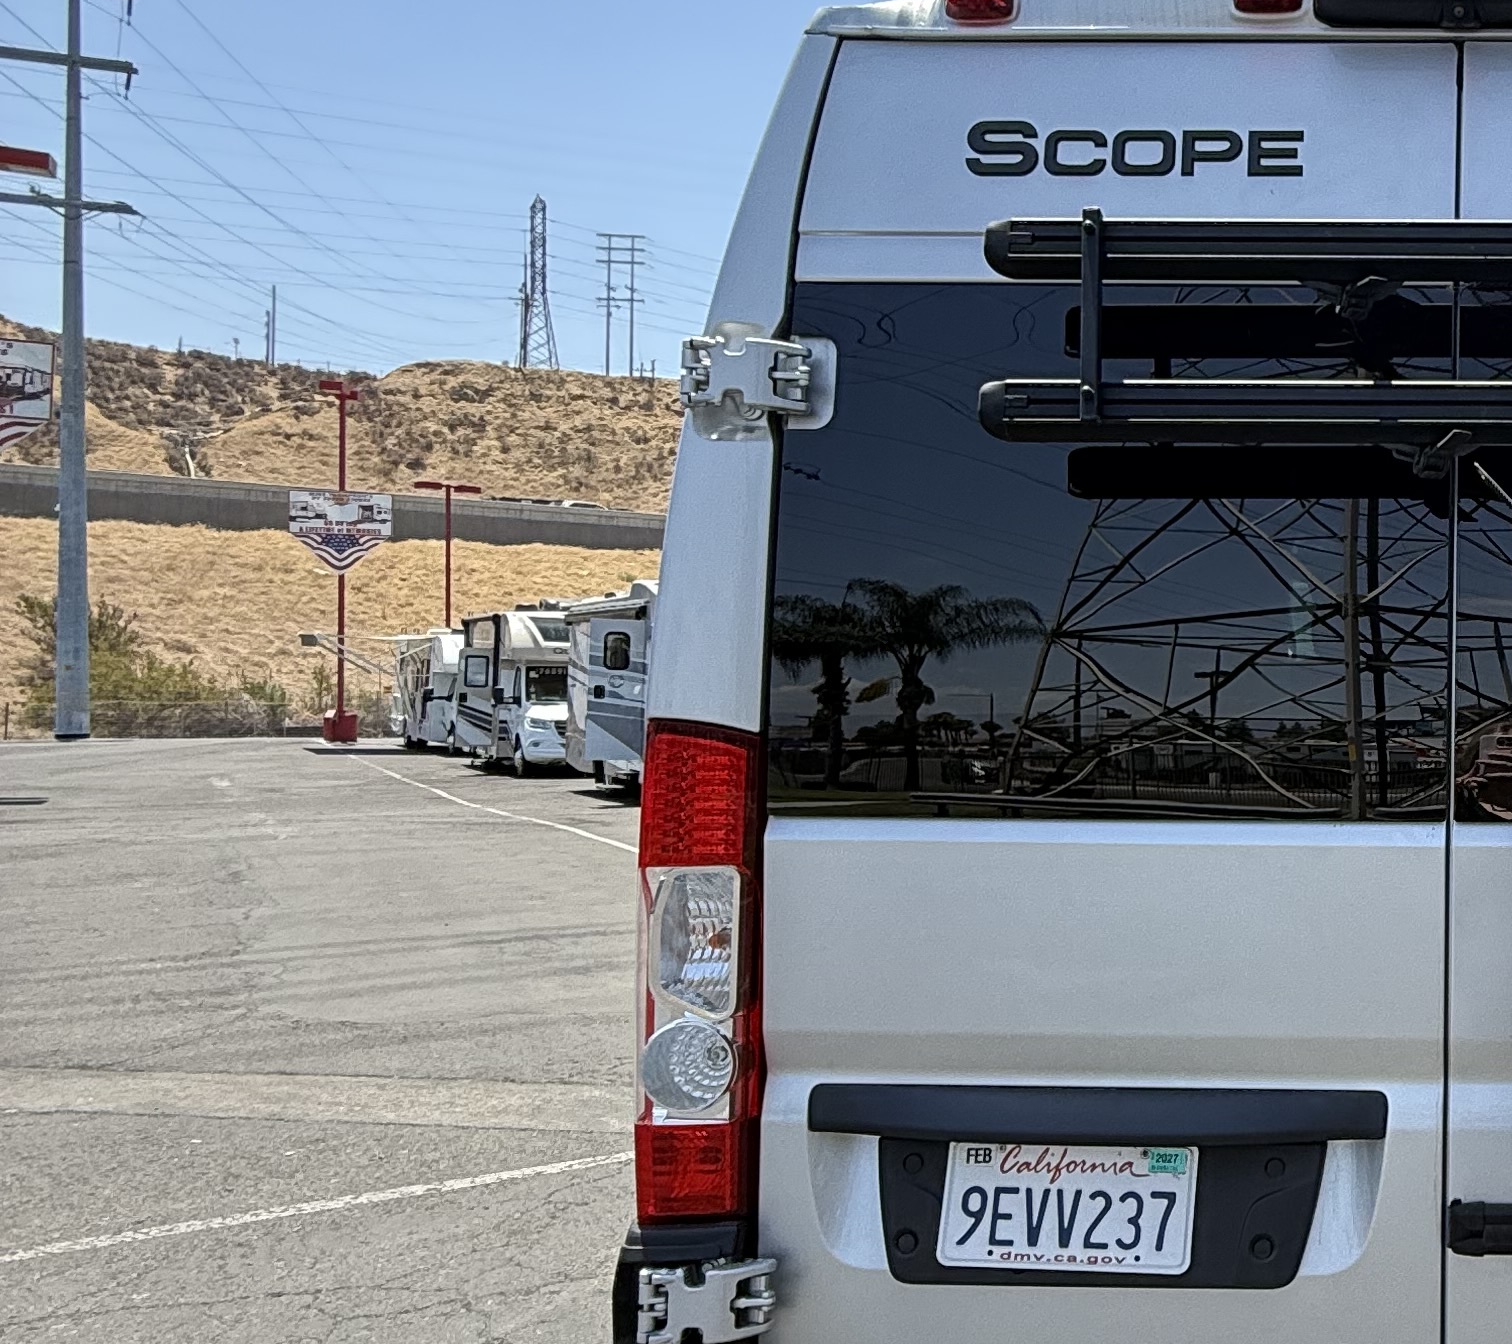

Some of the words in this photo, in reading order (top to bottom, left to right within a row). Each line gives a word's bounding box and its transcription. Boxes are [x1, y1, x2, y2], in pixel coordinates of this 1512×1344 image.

[965, 120, 1305, 177] SCOPE
[966, 1147, 992, 1164] FEB
[1000, 1145, 1150, 1184] California
[1155, 1152, 1179, 1164] 2027
[956, 1186, 1177, 1252] 9EVV237
[1000, 1251, 1126, 1265] dmv.ca.gov
